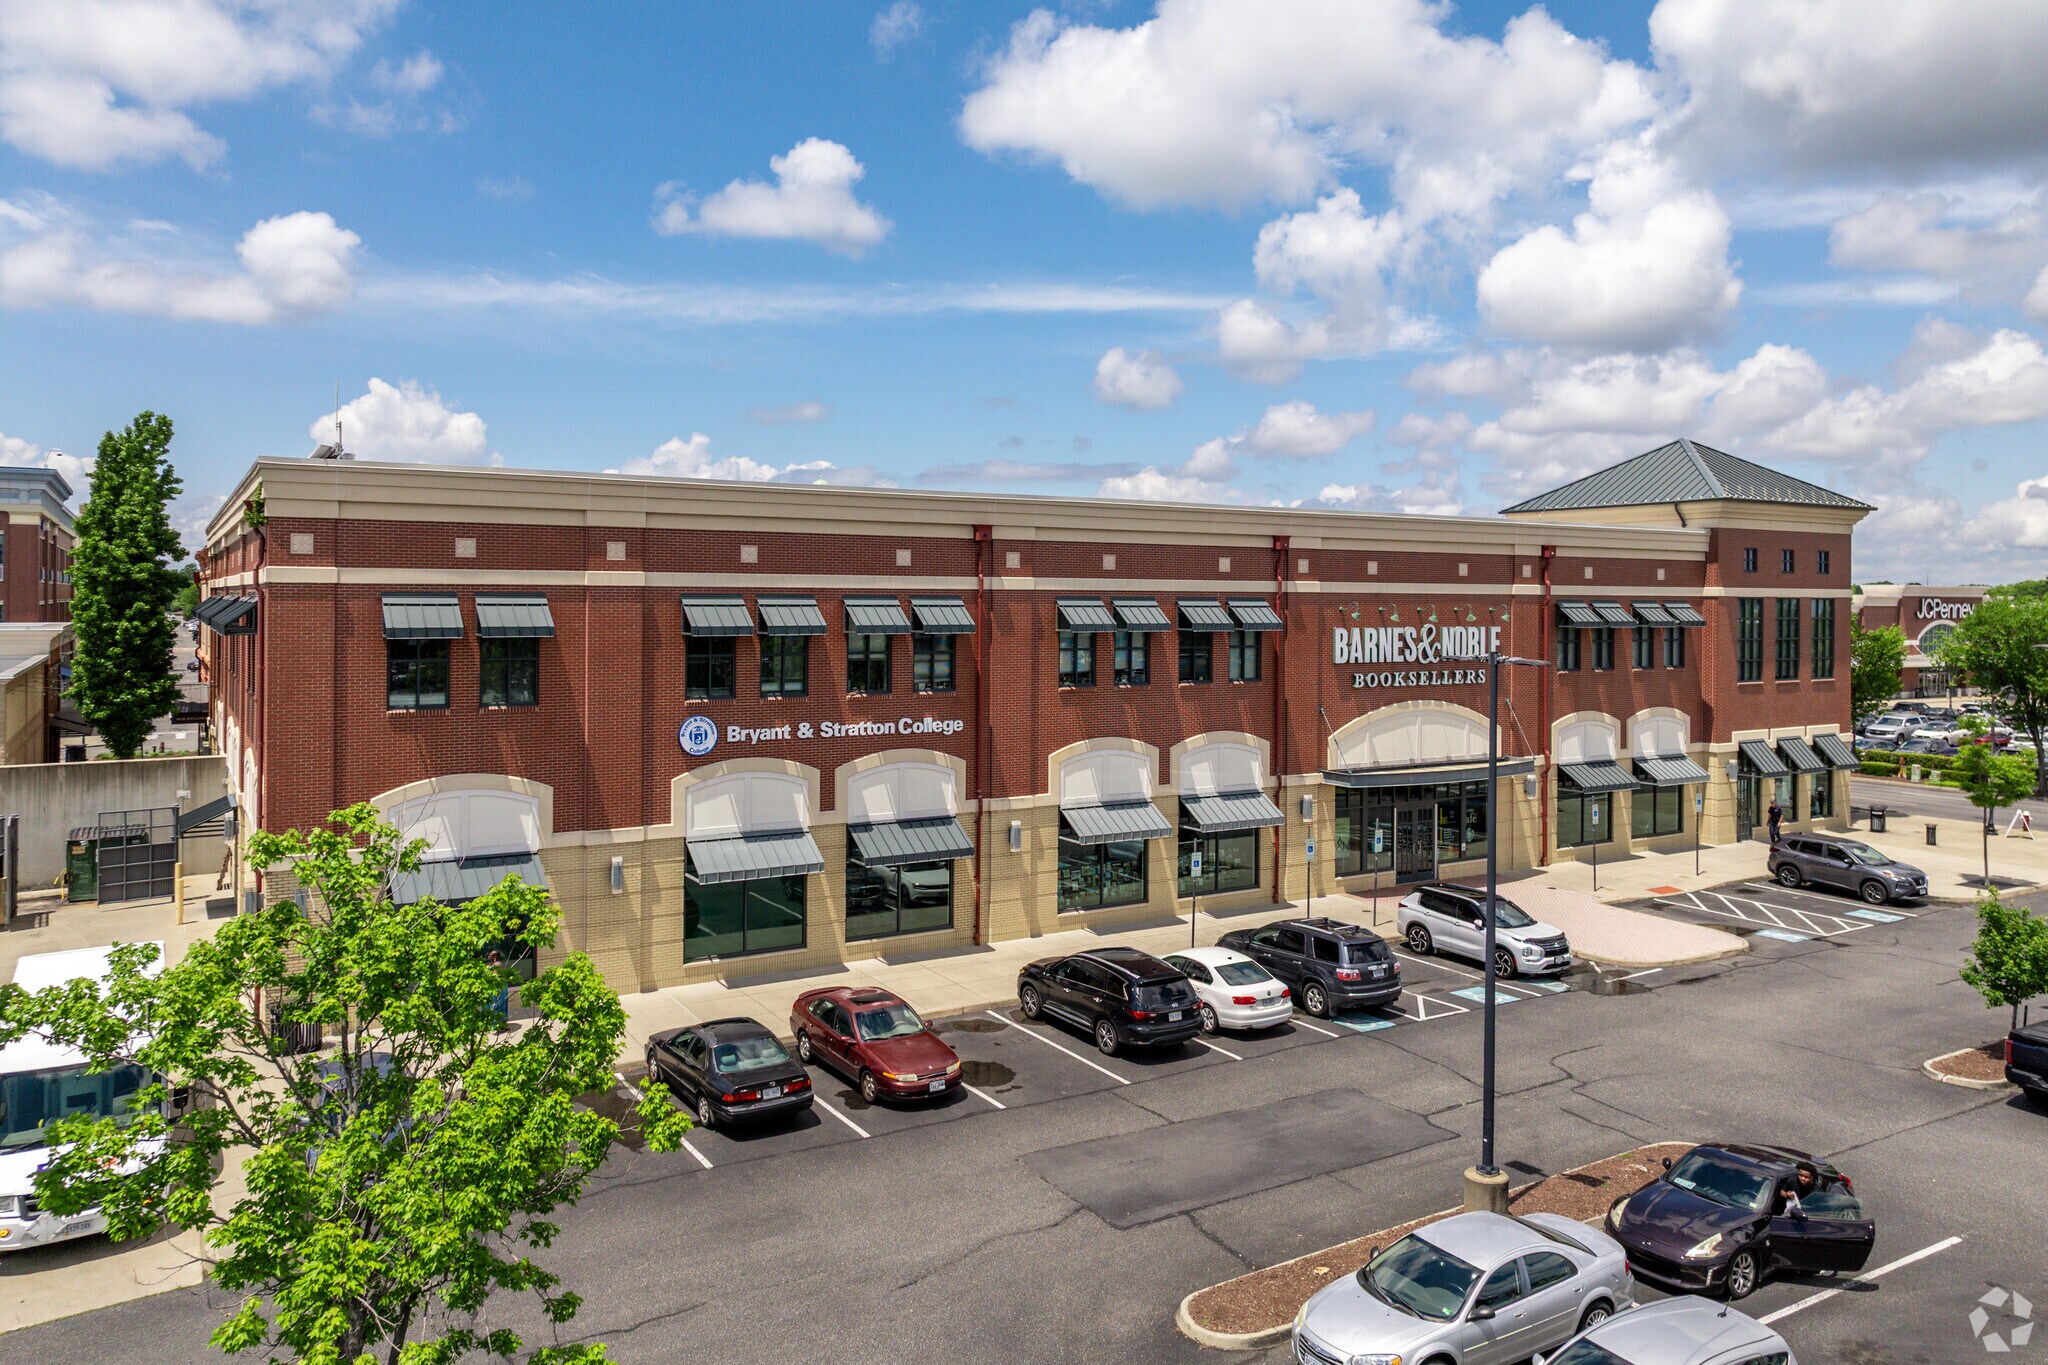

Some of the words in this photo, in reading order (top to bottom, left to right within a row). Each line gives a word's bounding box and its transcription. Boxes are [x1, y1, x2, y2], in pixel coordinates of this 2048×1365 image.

[1916, 598, 1975, 619] JCPenney
[1333, 627, 1417, 664] BARNES
[1417, 624, 1441, 664] &
[1353, 669, 1486, 688] BOOKSELLERS
[727, 724, 791, 745] Bryant
[797, 722, 814, 739] &
[820, 721, 896, 738] Stratton
[898, 717, 964, 735] College
